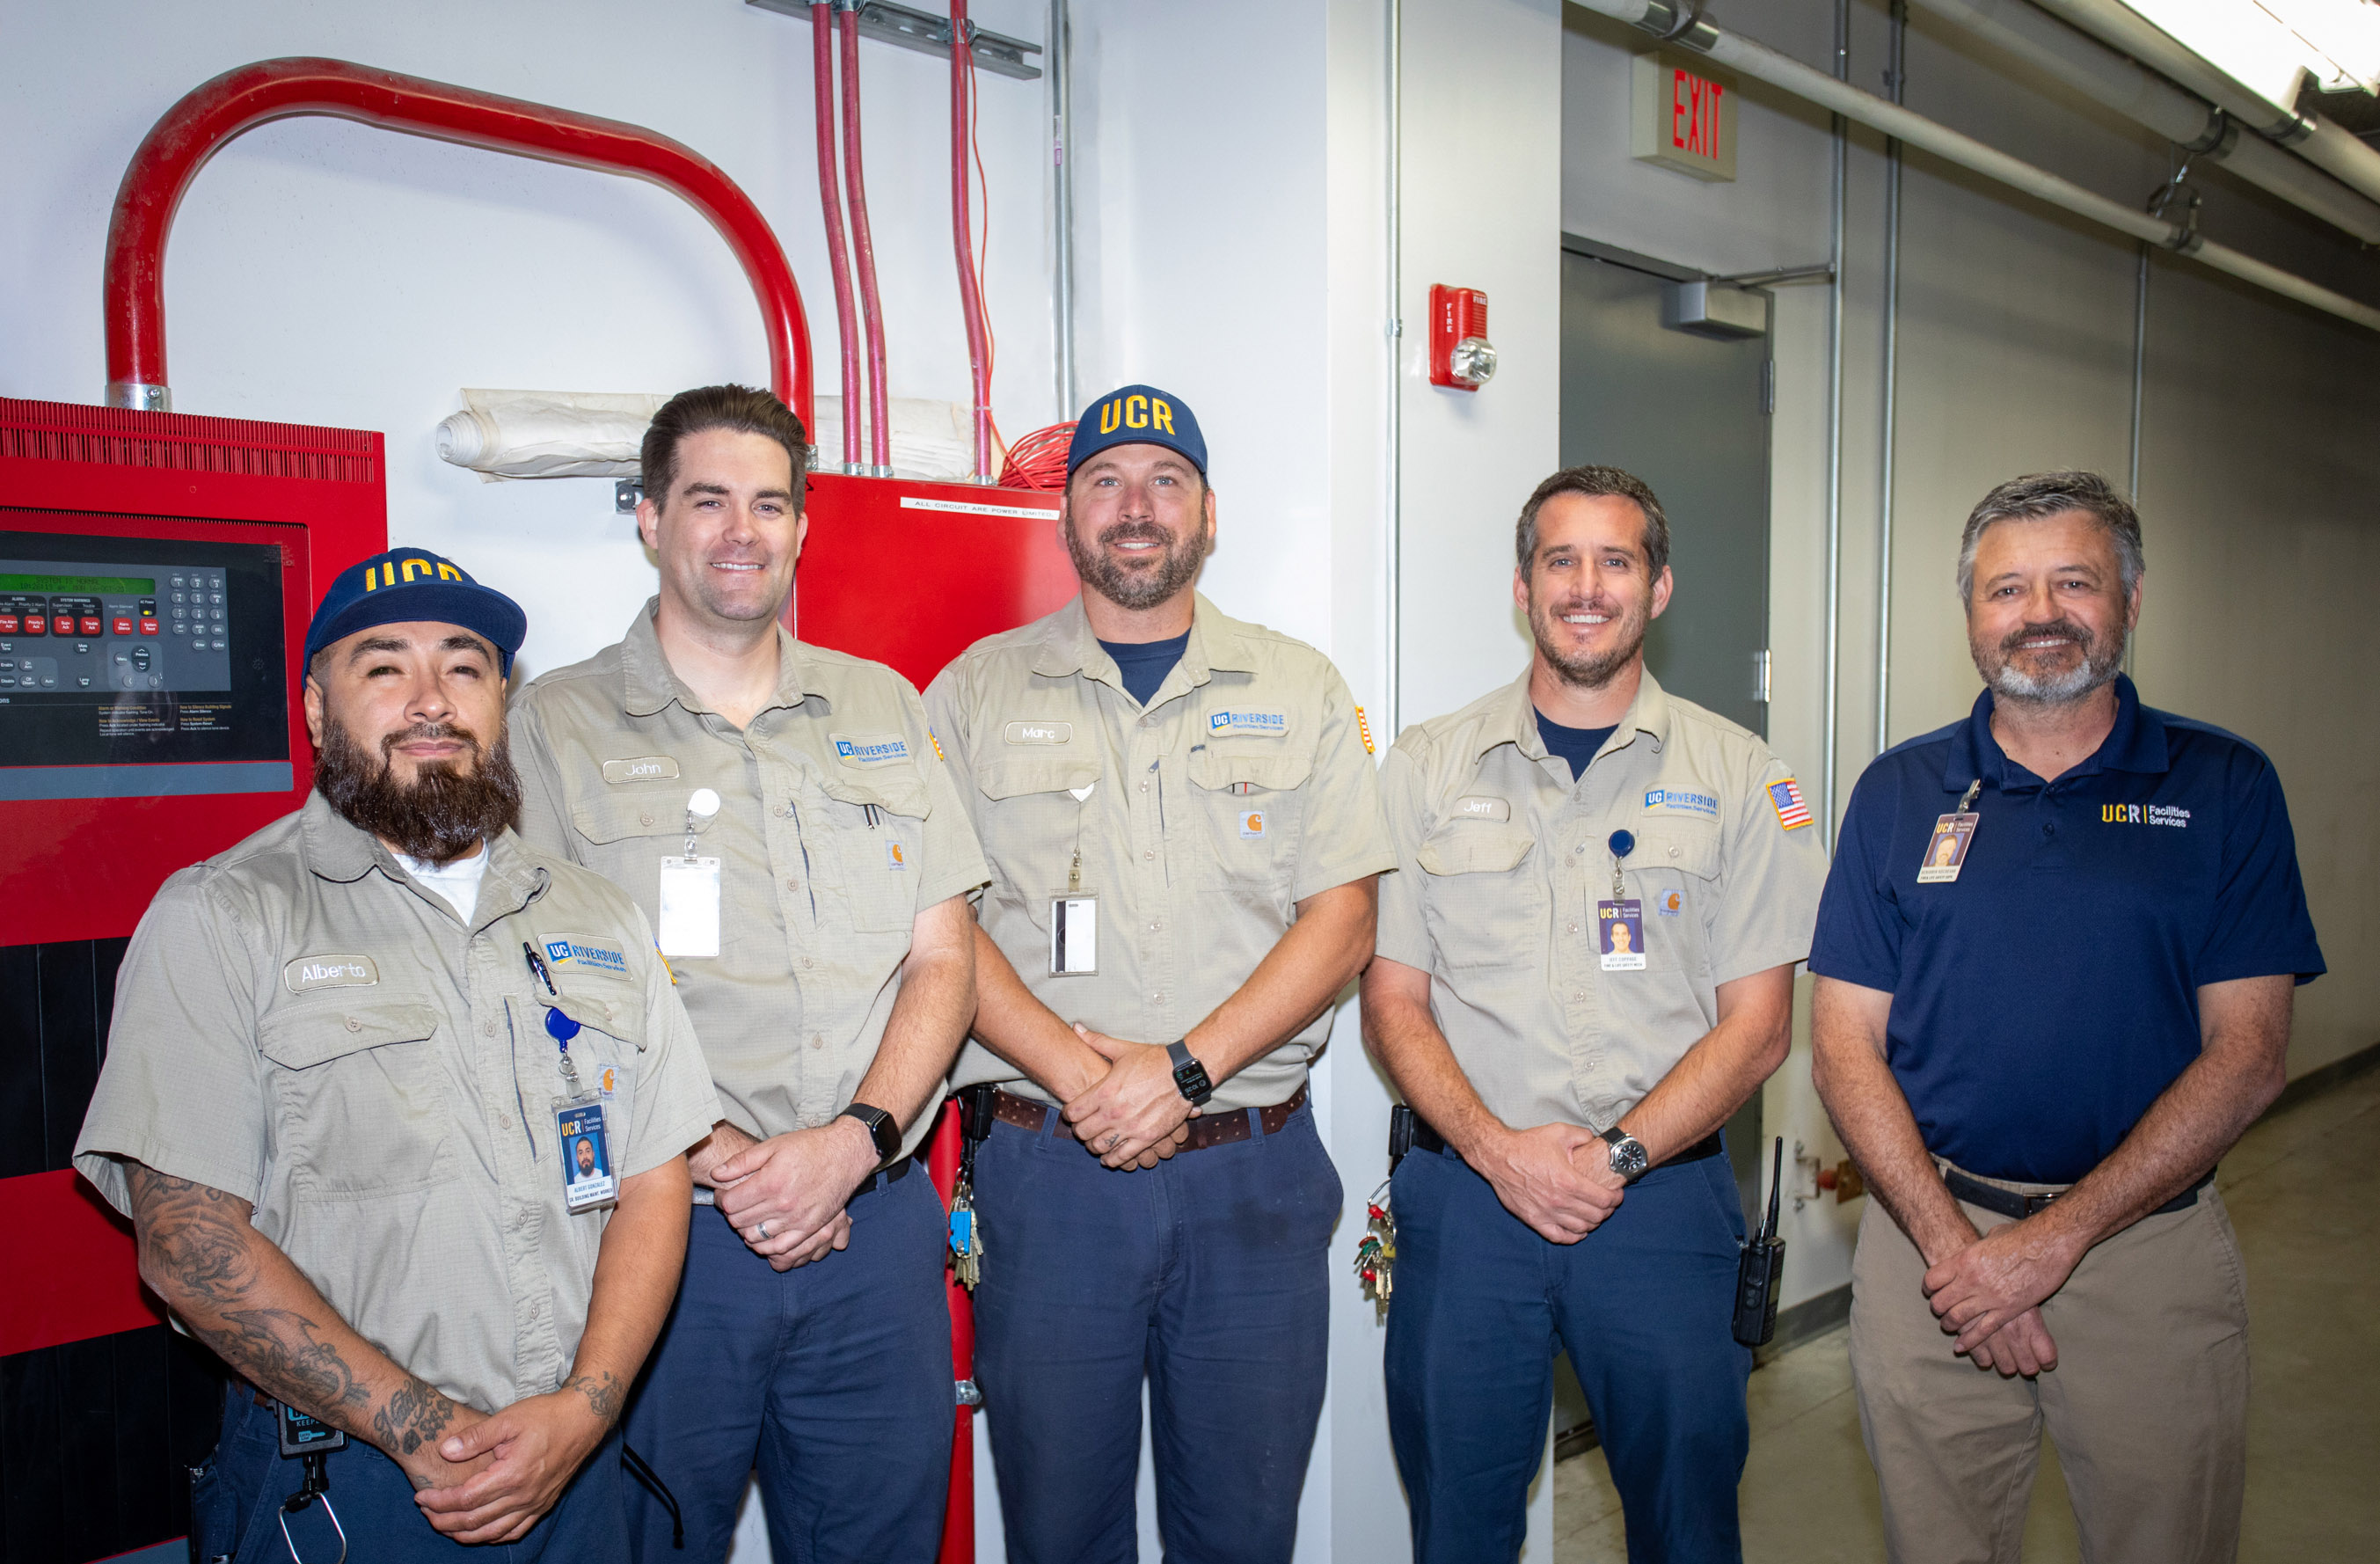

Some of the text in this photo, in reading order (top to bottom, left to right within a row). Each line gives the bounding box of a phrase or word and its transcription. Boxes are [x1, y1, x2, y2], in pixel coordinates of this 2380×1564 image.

[1673, 69, 1722, 160] EXIT
[1100, 395, 1175, 435] UCR
[1214, 713, 1284, 726] UC RIVERSIDE
[1022, 727, 1055, 739] Marc
[839, 741, 907, 756] UC RIVERSIDE
[625, 764, 661, 776] John
[1464, 800, 1492, 814] Jeff
[1648, 792, 1717, 809] UC RIVERSIDE
[1693, 806, 1716, 815] Services
[2102, 804, 2141, 823] UCR
[2150, 805, 2190, 818] Facilities
[1937, 822, 1954, 833] UCR
[2150, 815, 2187, 828] Services
[1600, 908, 1619, 919] UCR
[550, 945, 625, 965] UC RIVERSIDE
[577, 959, 602, 968] Facilities
[303, 962, 365, 983] Alberto
[562, 1121, 581, 1136] UCR
[588, 1180, 605, 1189] GONZALEZ
